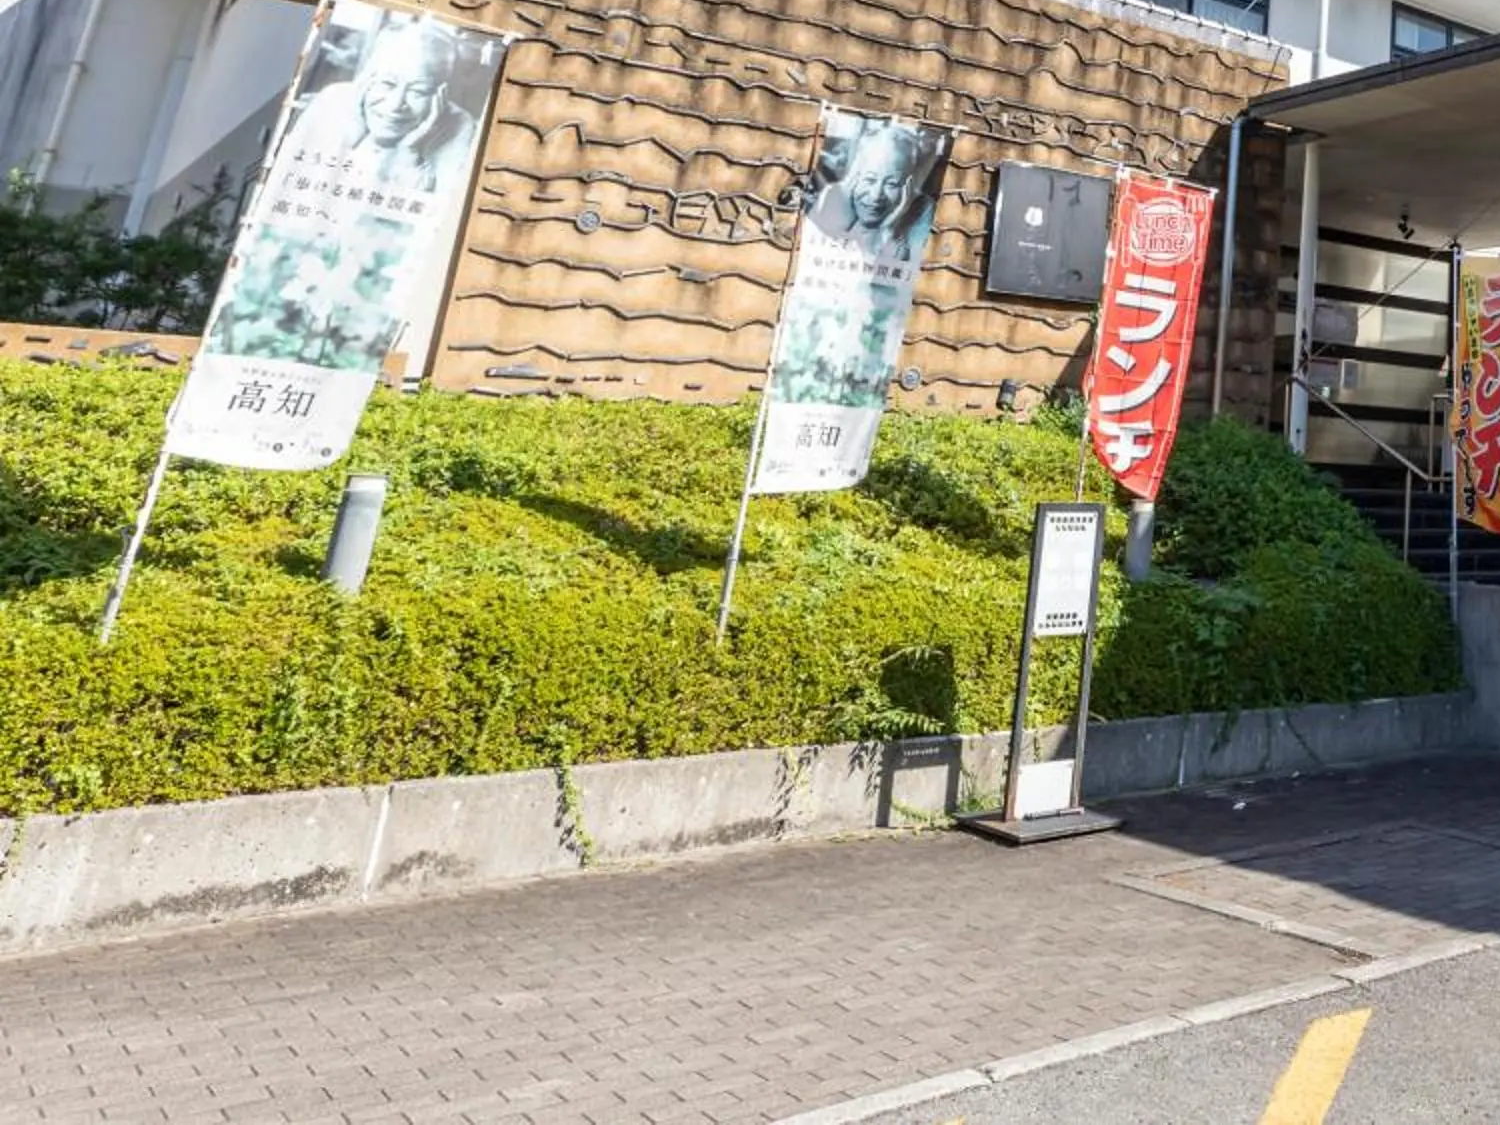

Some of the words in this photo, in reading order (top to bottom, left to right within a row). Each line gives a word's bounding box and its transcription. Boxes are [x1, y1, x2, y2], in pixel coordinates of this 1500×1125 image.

[1098, 273, 1178, 472] ランチ
[227, 379, 317, 418] 高知
[796, 420, 842, 449] 高知
